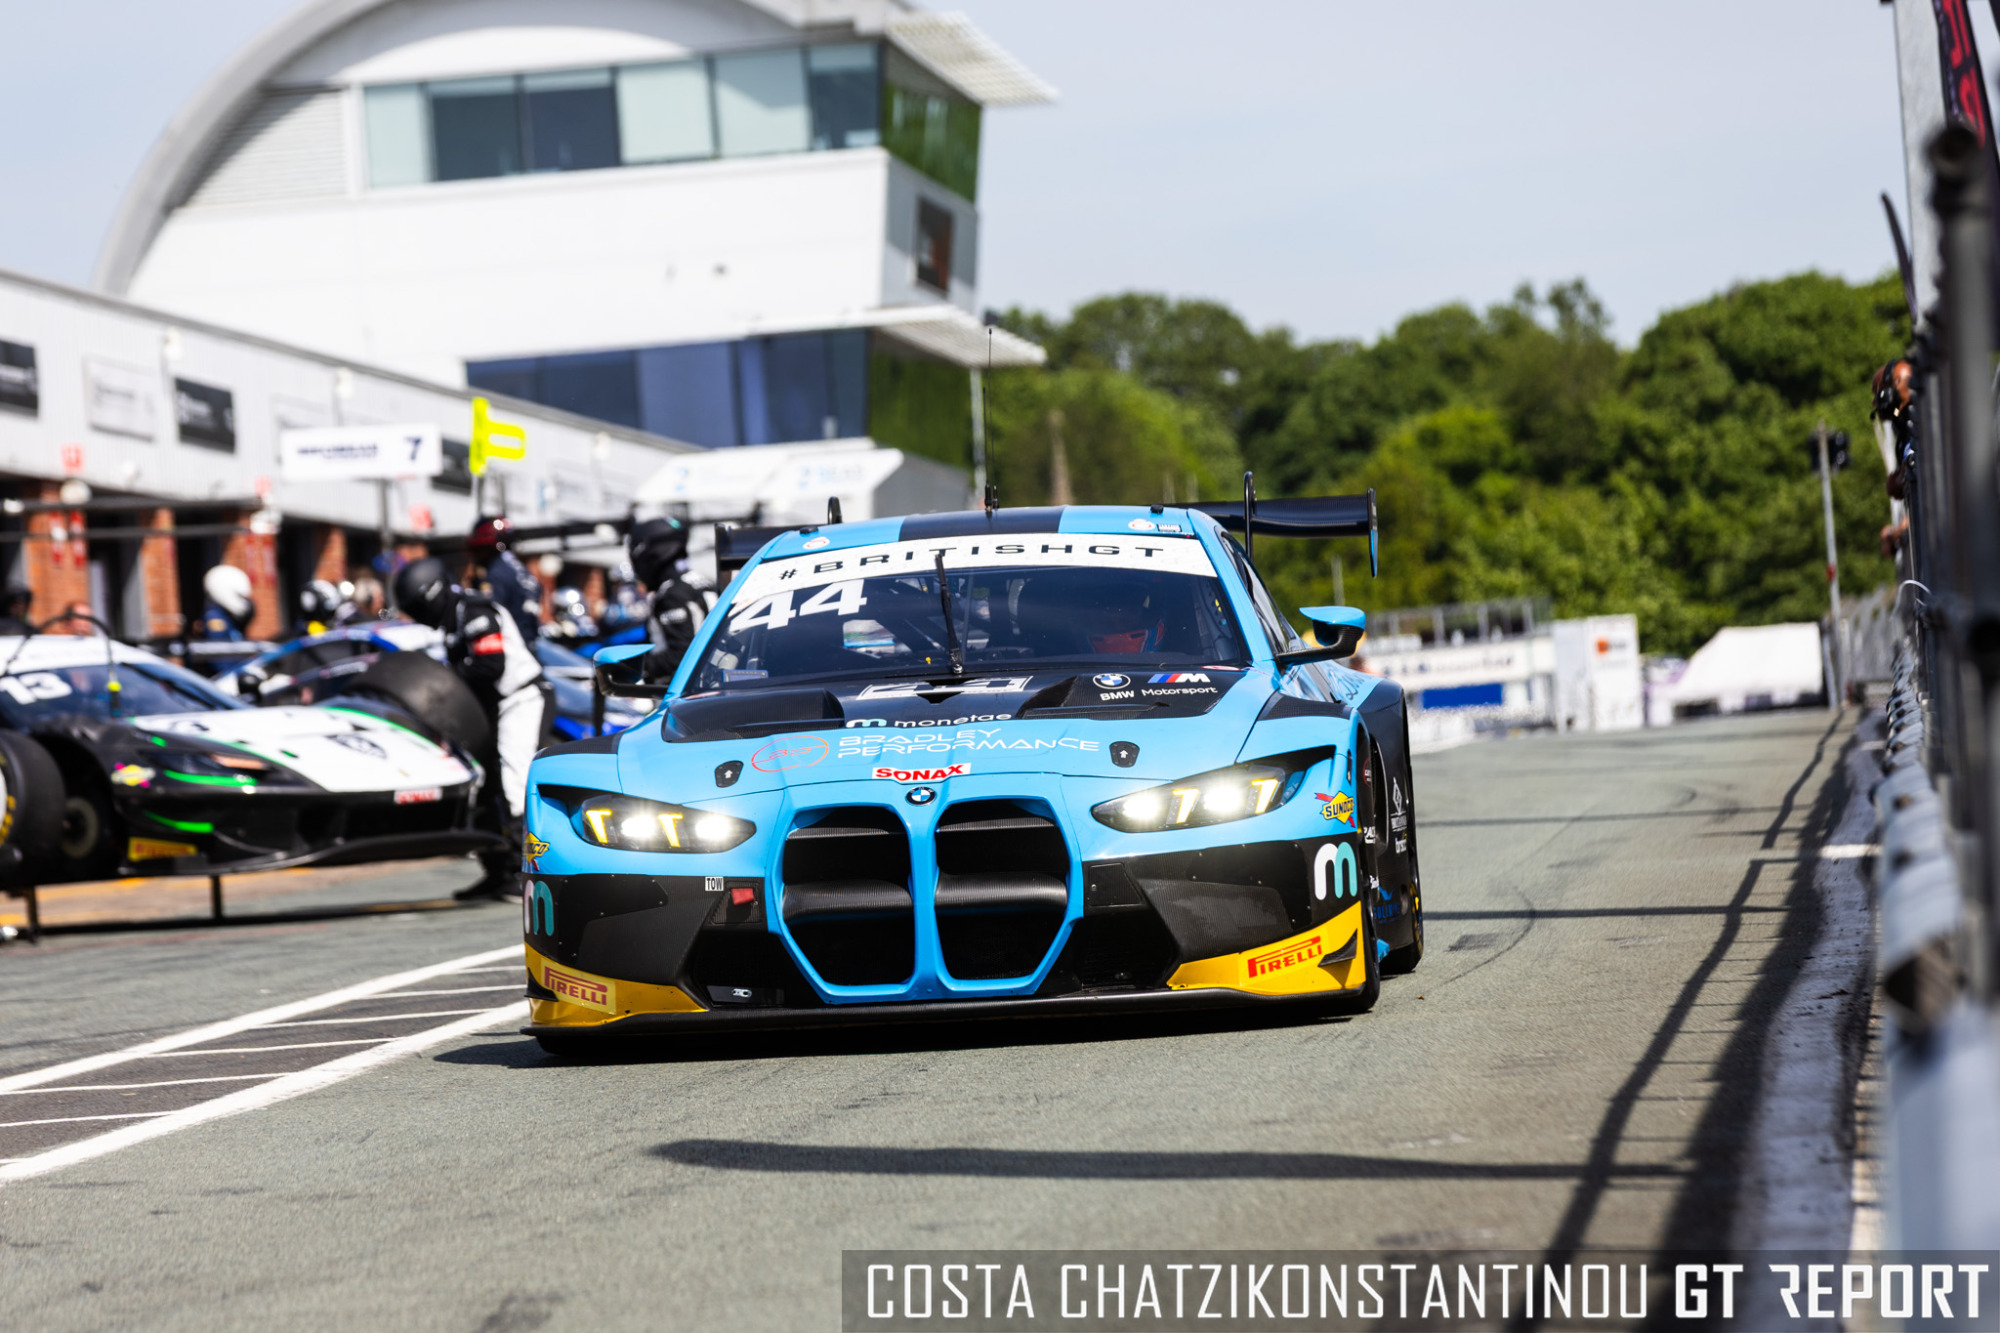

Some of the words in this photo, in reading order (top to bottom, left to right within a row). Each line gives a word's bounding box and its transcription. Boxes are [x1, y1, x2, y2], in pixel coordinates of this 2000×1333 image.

[404, 434, 423, 461] 7
[729, 578, 868, 636] 44
[0, 671, 73, 705] 13
[1100, 690, 1135, 701] BMW
[1141, 686, 1218, 697] Motorsport
[894, 713, 1012, 728] monetae
[838, 728, 1002, 746] BRADLEY
[838, 737, 1100, 758] PERFORMANCE
[875, 763, 964, 782] SONAX
[1325, 799, 1354, 818] SUNOCO
[706, 877, 723, 890] TOW
[1247, 935, 1323, 979] PIRELLI
[543, 965, 609, 1006] PIRELLI
